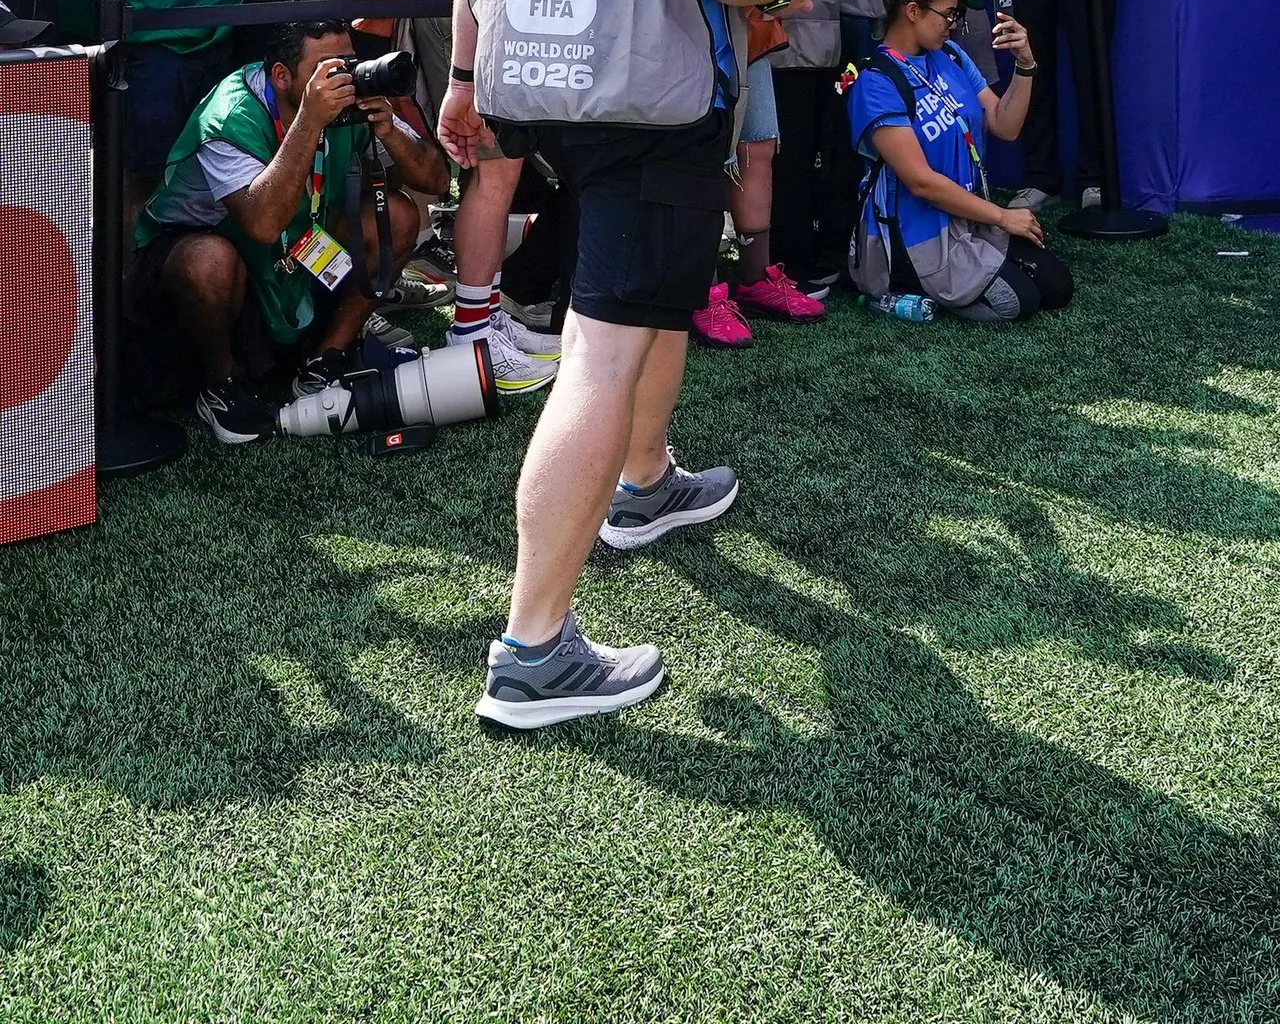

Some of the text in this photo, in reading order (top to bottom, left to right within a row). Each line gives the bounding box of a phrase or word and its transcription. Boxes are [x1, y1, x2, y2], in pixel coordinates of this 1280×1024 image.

[529, 0, 574, 18] FIFA
[504, 40, 595, 60] WORLD CUP
[502, 59, 594, 90] 2026
